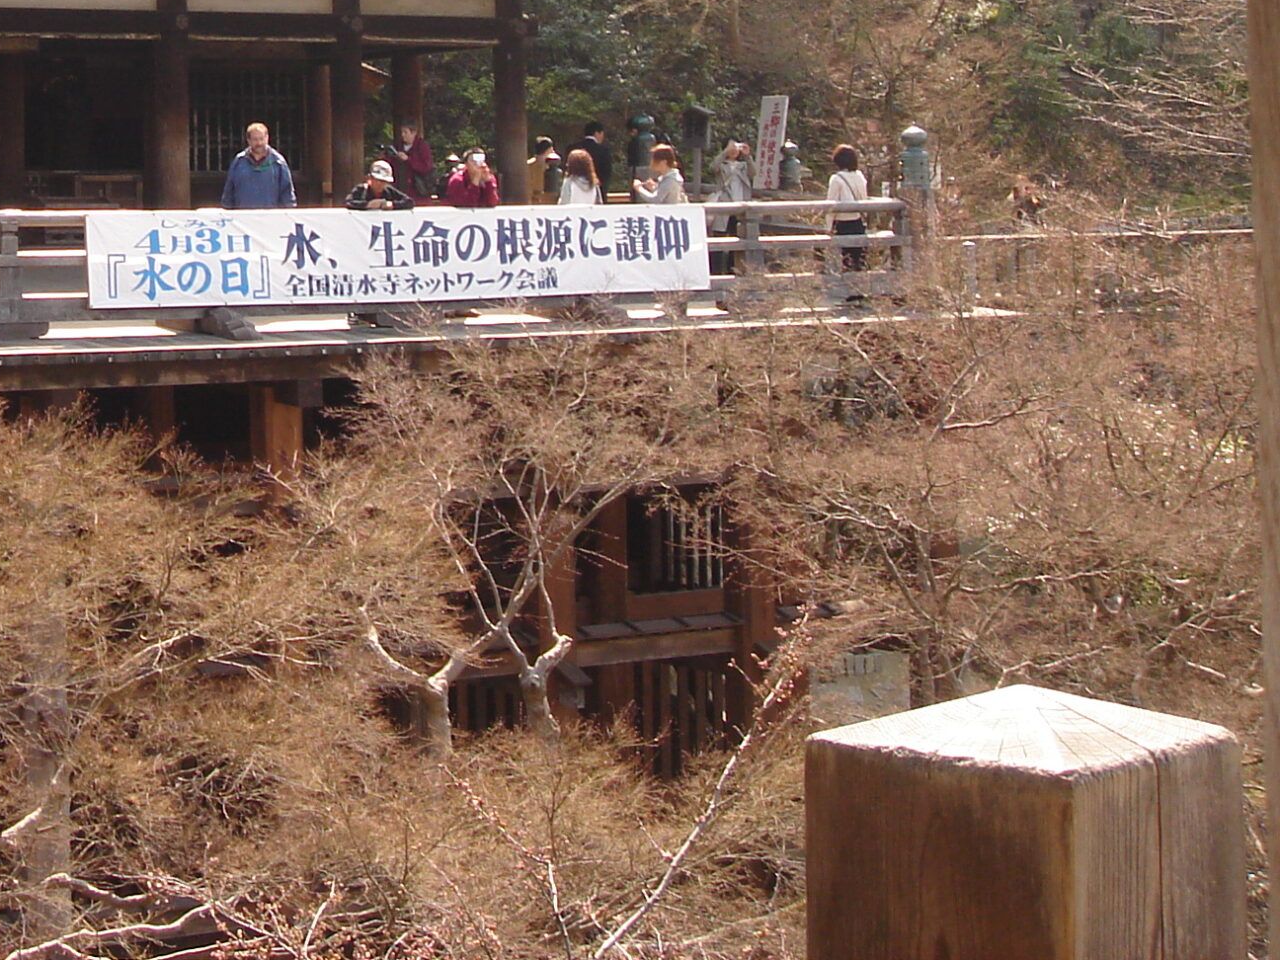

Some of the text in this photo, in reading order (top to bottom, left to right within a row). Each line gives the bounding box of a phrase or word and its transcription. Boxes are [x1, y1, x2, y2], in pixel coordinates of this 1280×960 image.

[161, 218, 233, 229] しみず
[134, 228, 251, 255] 4月3日
[107, 253, 271, 302] 『水の日』
[285, 266, 559, 298] 全国清水寺ネットワーク会議
